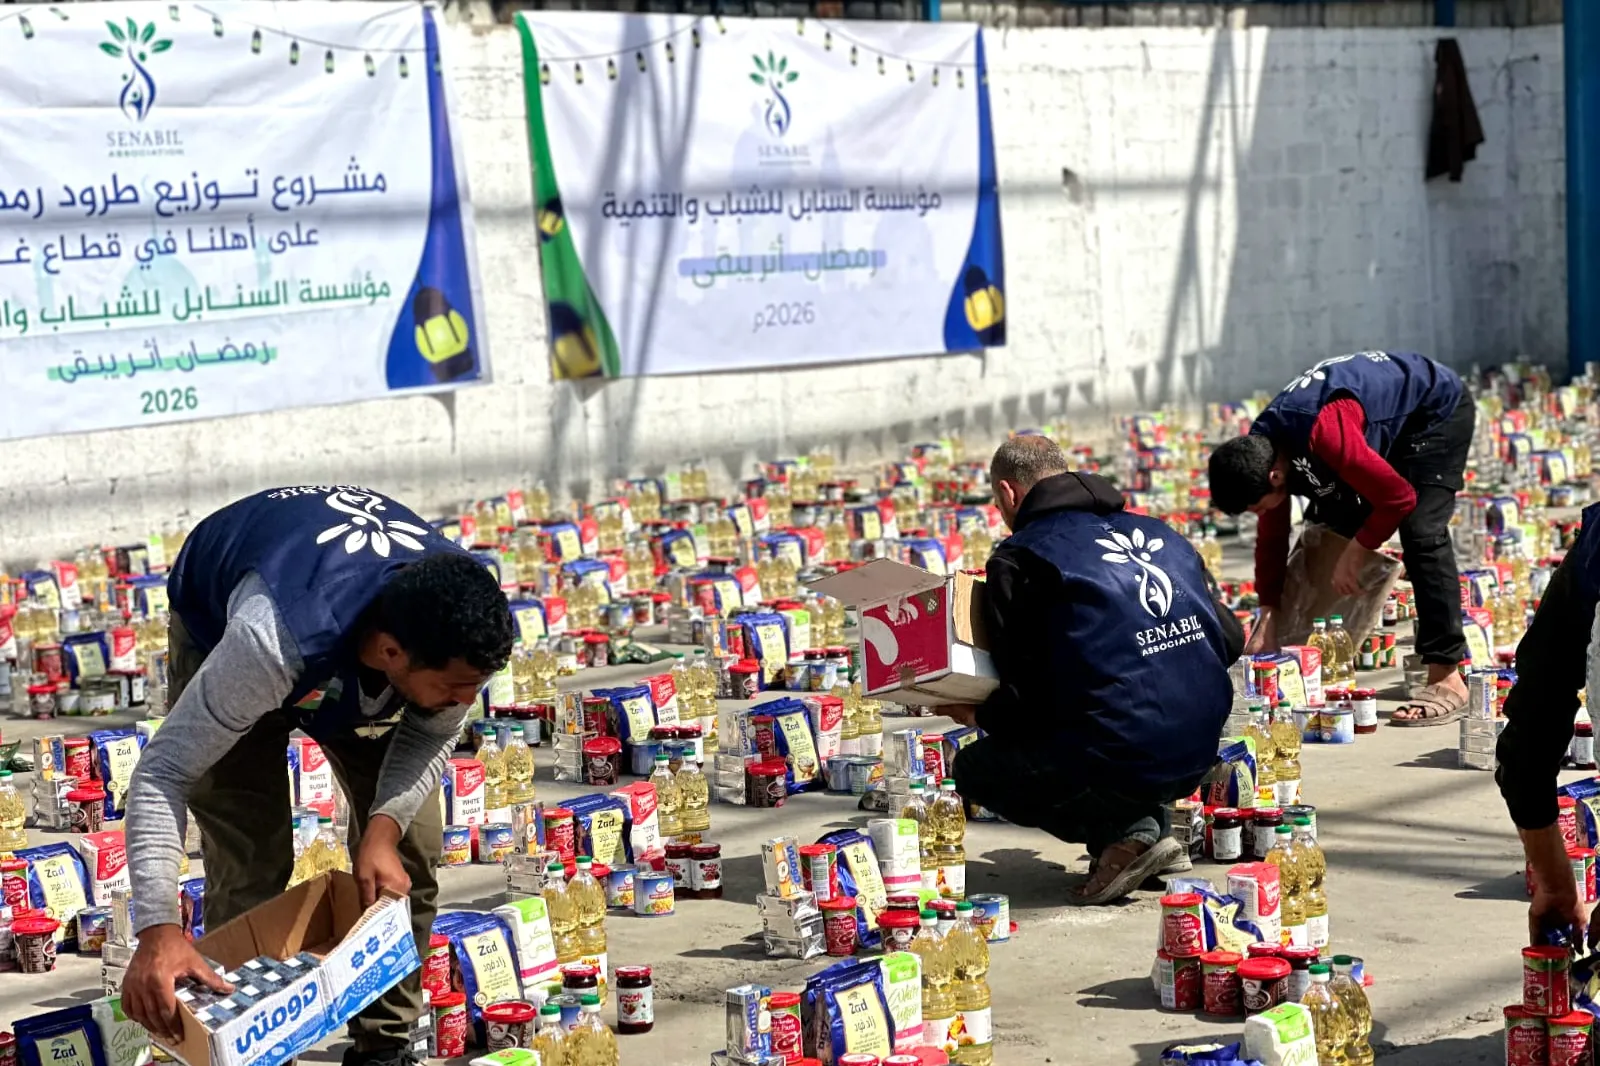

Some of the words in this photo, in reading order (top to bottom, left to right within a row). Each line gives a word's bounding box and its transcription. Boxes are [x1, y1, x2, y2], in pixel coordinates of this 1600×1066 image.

[106, 130, 183, 147] SENABIL
[59, 172, 140, 217] طرود
[154, 168, 259, 217] توزيع
[602, 191, 698, 227] والتنمية
[705, 184, 783, 224] للشباب
[788, 187, 860, 221] السنابل
[865, 183, 942, 218] مؤسسة
[134, 229, 177, 270] في
[187, 213, 256, 254] أهلنا
[268, 221, 319, 254] على
[43, 232, 121, 274] قطاع
[173, 279, 288, 321] السنابل
[299, 271, 391, 305] مؤسسة
[40, 285, 161, 332] للشباب
[176, 337, 271, 372] رمضان
[141, 386, 199, 415] 2026
[1136, 615, 1201, 646] SENABIL
[116, 747, 132, 757] Zad
[461, 798, 480, 806] WHITE
[461, 807, 481, 816] SUGAR
[597, 818, 615, 829] Zad
[45, 866, 65, 878] Zad
[103, 879, 125, 890] WHITE
[476, 940, 498, 956] Zad
[235, 981, 317, 1054] دومتي
[848, 999, 868, 1015] Zad
[51, 1043, 77, 1060] Zad
